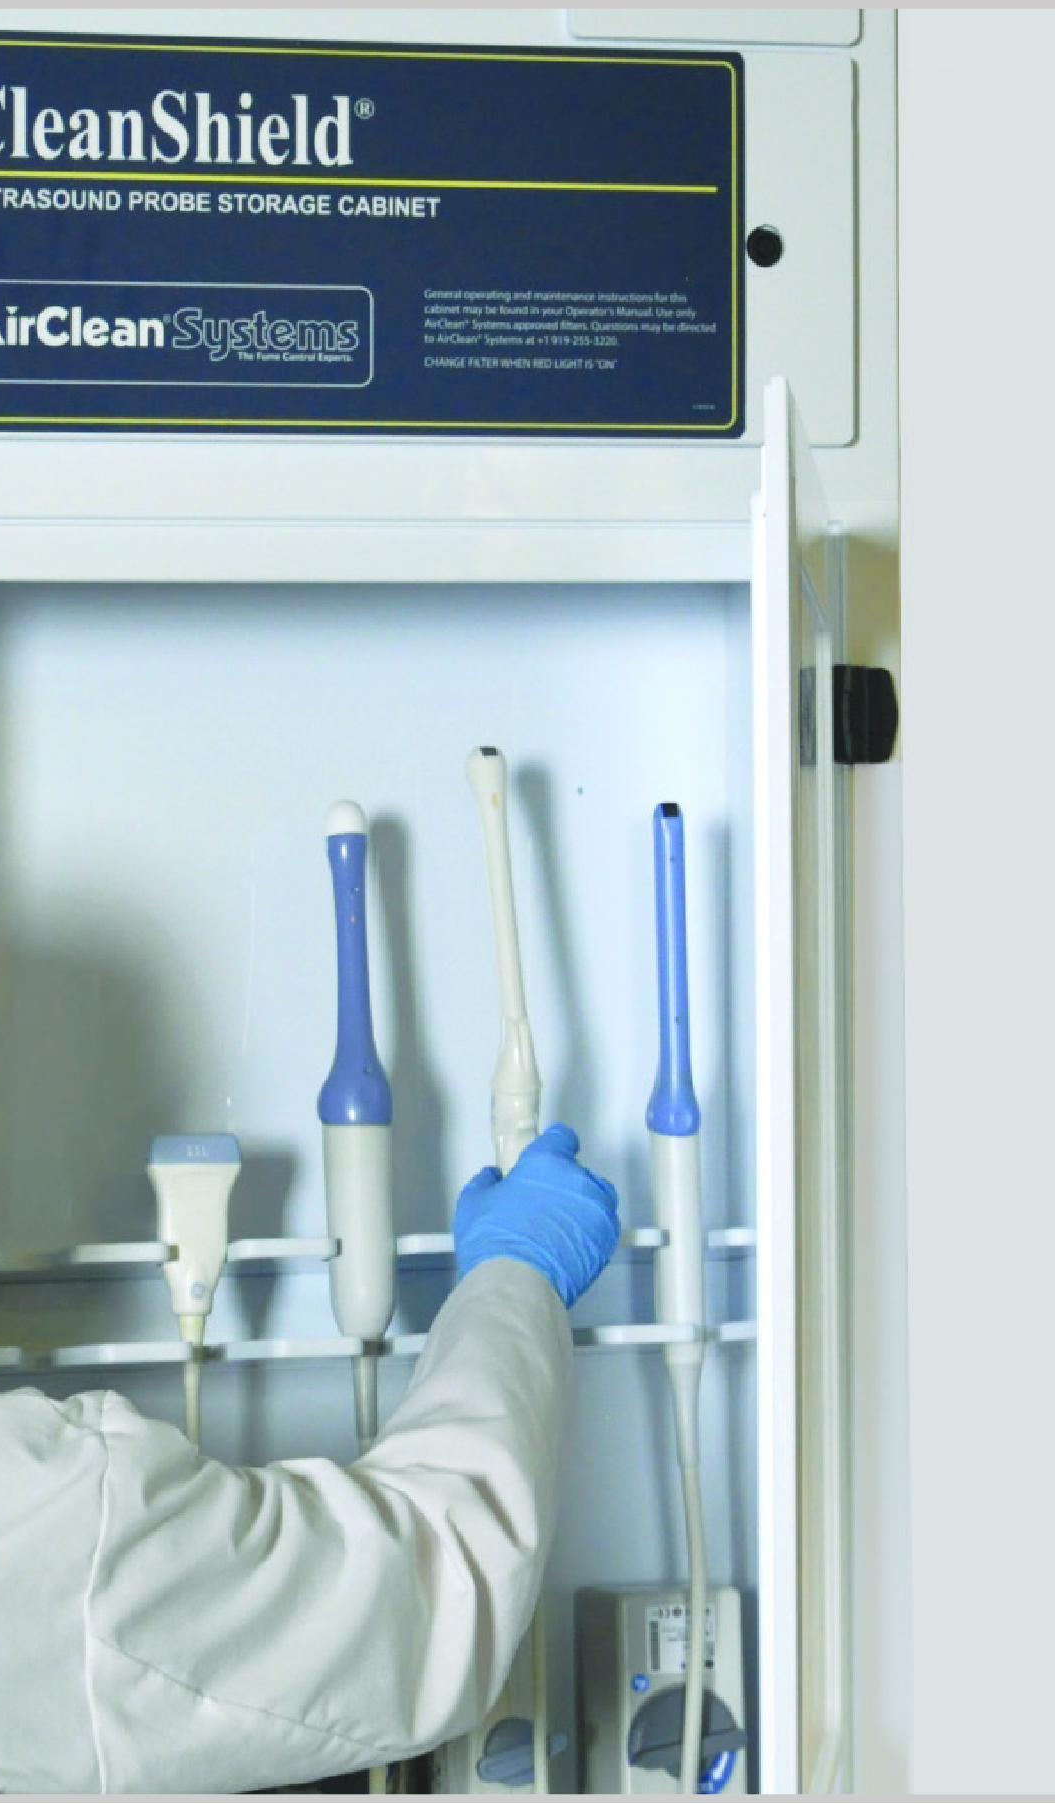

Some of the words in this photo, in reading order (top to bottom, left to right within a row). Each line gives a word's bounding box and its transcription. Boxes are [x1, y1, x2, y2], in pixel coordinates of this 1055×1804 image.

[128, 192, 212, 213] PROBE
[217, 194, 332, 216] STORAGE
[337, 195, 441, 218] CABINET
[424, 288, 462, 300] General
[463, 290, 512, 303] operating
[513, 290, 532, 301] and
[533, 291, 595, 302] maintenance
[597, 291, 654, 303] instructions
[654, 291, 668, 302] for
[669, 291, 688, 304] this
[424, 304, 460, 315] cabinet
[462, 306, 483, 317] may
[485, 304, 497, 315] be
[499, 304, 529, 315] found
[530, 305, 540, 315] in
[542, 307, 564, 318] your
[656, 307, 674, 318] Use
[675, 307, 697, 320] only
[472, 319, 512, 332] Systems
[513, 321, 559, 332] approved
[591, 320, 638, 332] Questions
[640, 323, 661, 334] may
[662, 322, 676, 332] be
[677, 322, 717, 333] directed
[171, 307, 360, 362] Systems
[424, 334, 435, 344] to
[484, 334, 524, 346] Systems
[525, 335, 535, 345] at
[238, 352, 254, 361] The
[256, 352, 281, 361] Fume
[282, 352, 316, 361] Control
[424, 356, 465, 368] CHANGE
[467, 357, 499, 368] FILTER
[499, 358, 531, 368] WHEN
[533, 358, 552, 369] RED
[554, 358, 583, 369] LIGHT
[584, 359, 595, 369] IS
